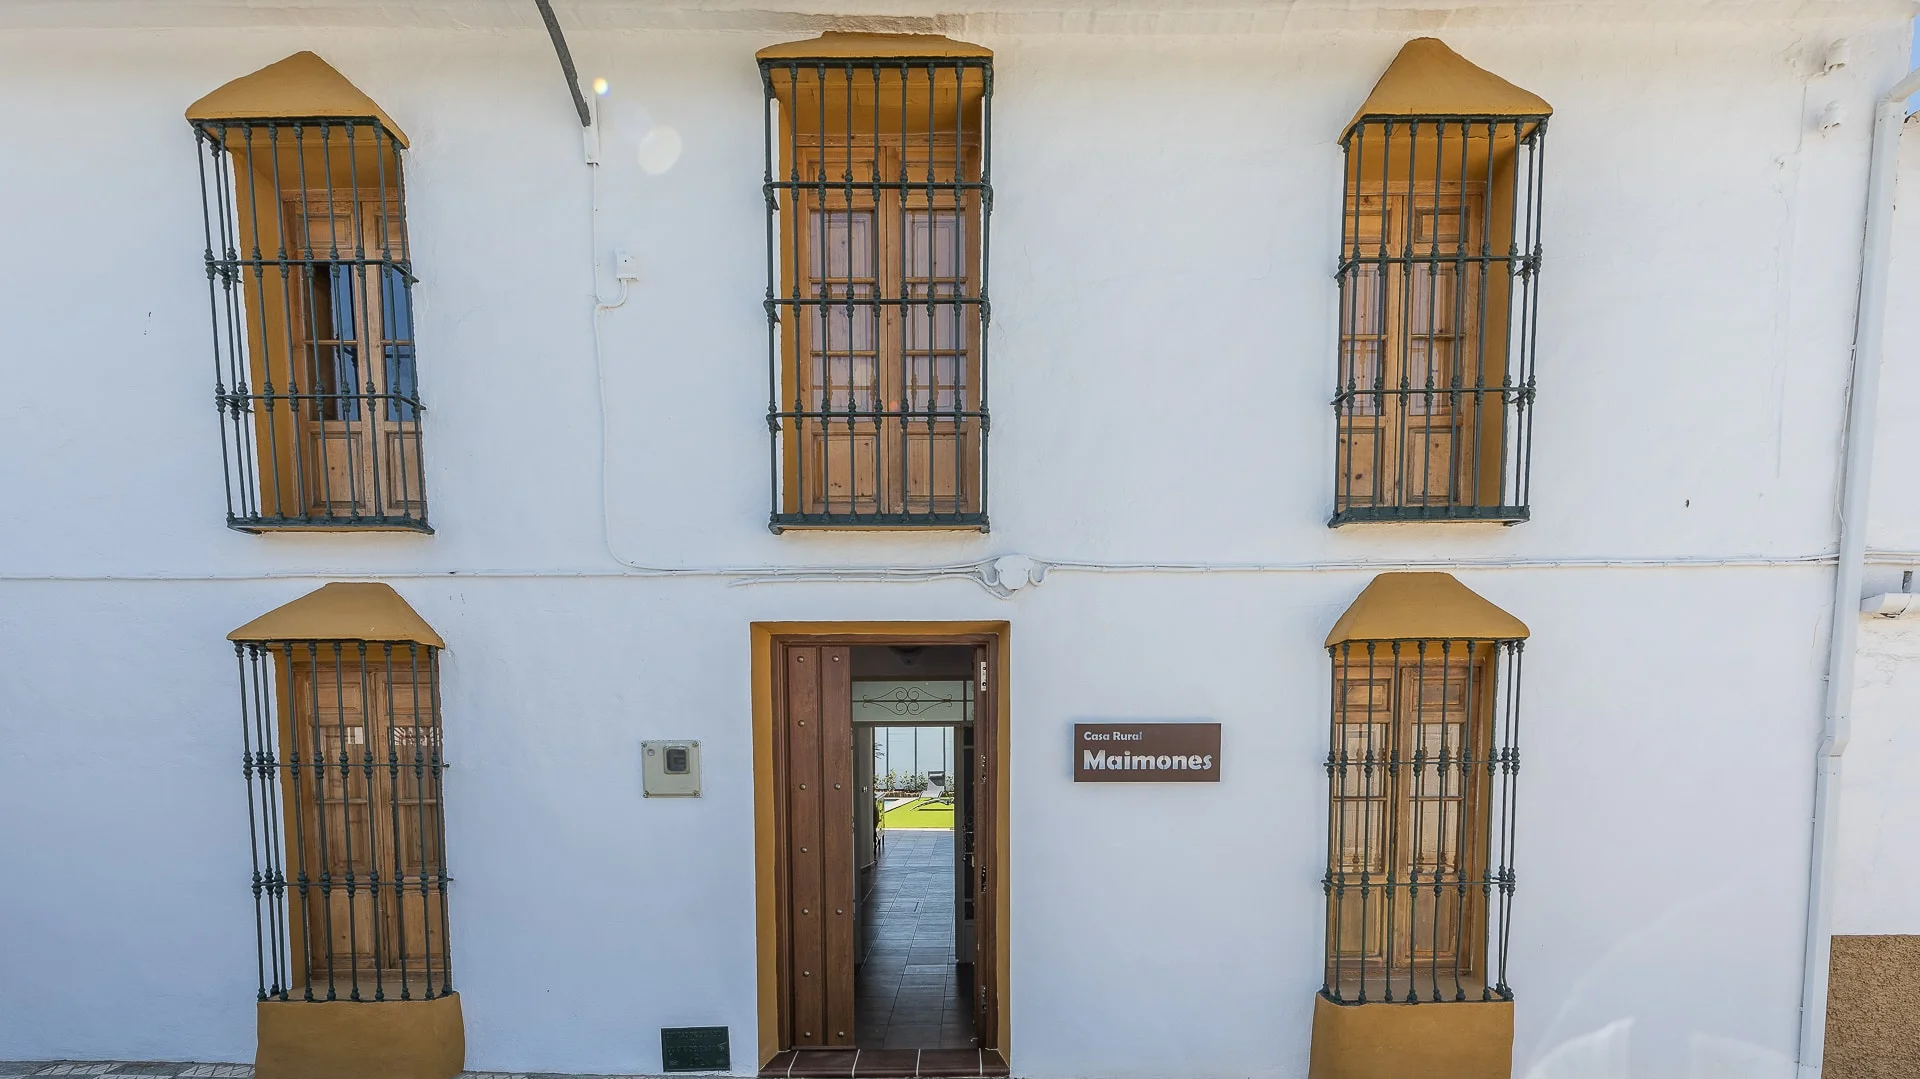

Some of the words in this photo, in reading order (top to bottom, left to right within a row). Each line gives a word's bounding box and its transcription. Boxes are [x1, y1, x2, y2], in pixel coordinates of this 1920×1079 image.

[1083, 731, 1110, 741] Casa
[1112, 731, 1143, 741] Rural
[1083, 749, 1213, 770] Maimones
